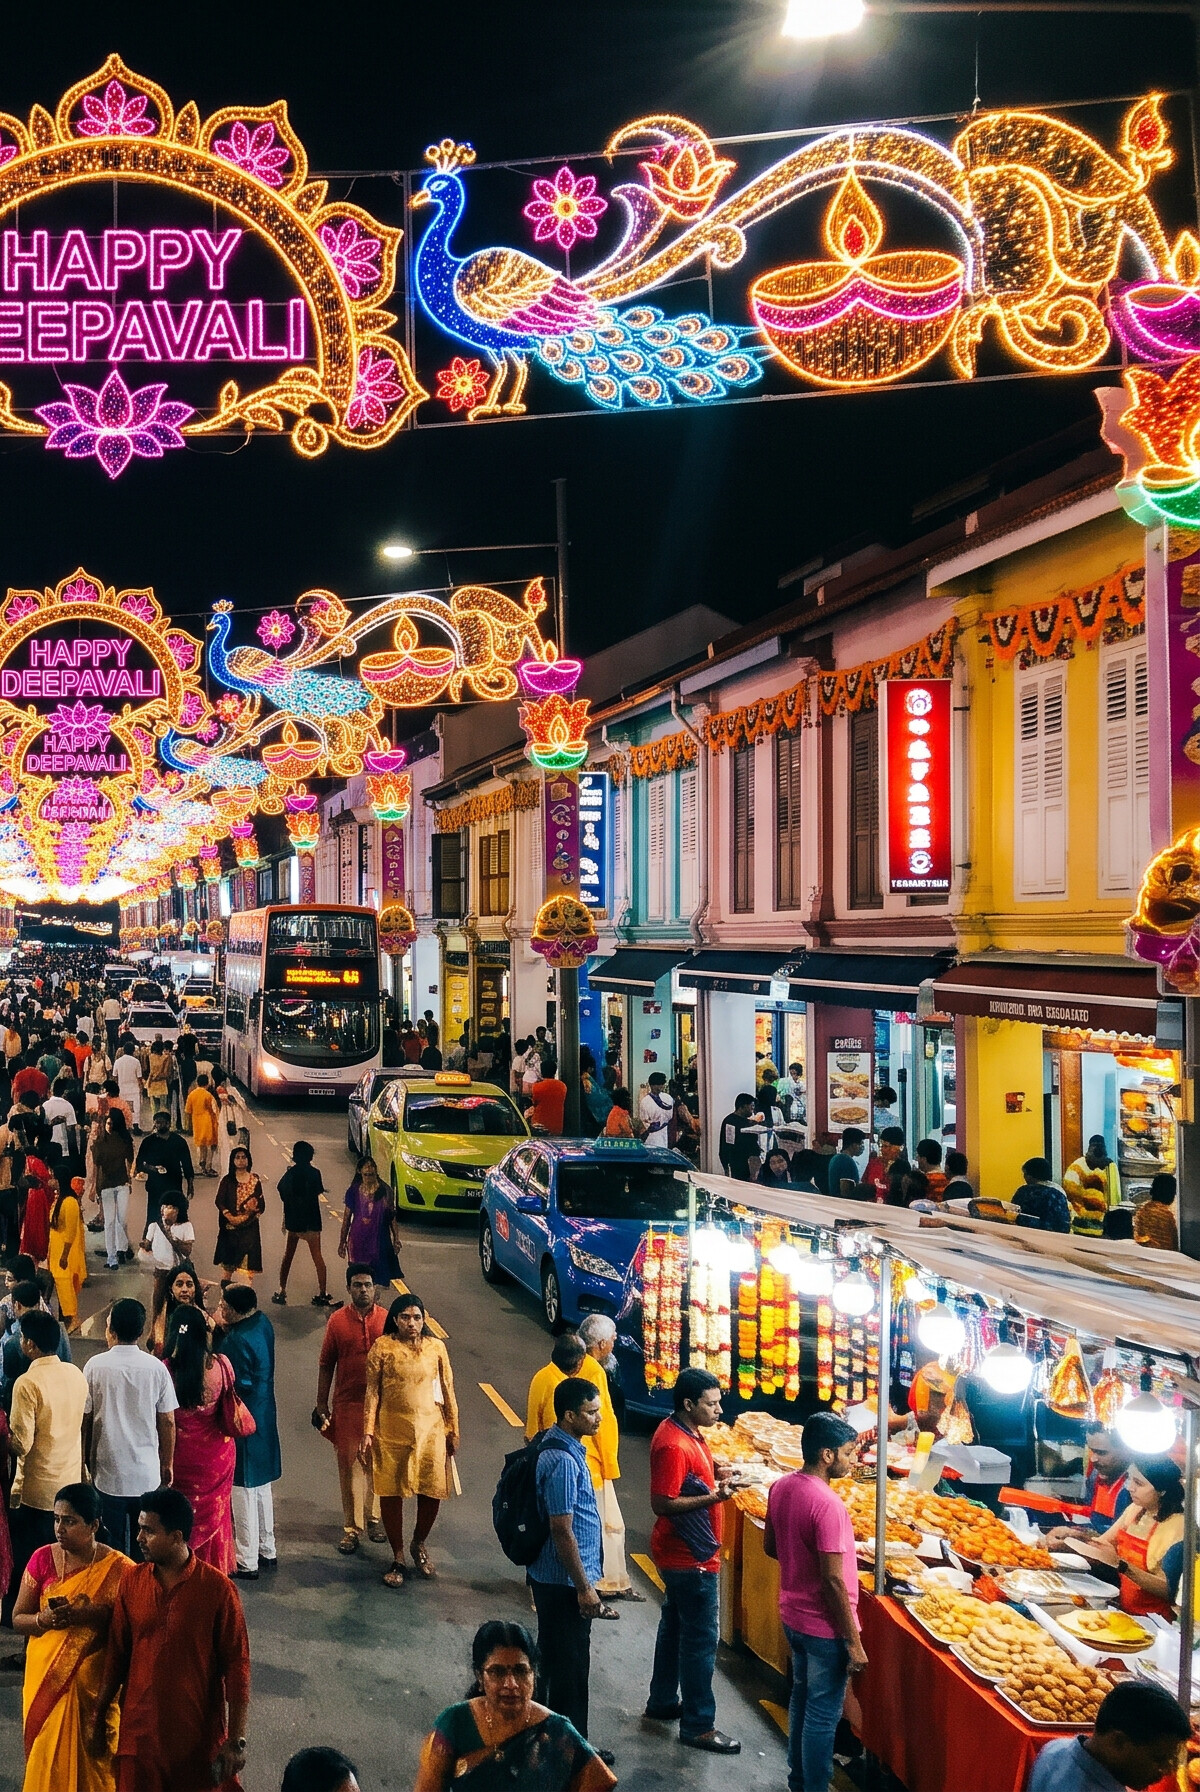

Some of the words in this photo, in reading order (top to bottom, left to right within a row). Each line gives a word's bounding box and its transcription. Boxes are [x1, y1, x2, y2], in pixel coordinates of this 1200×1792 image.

[2, 227, 242, 292] HAPPY
[30, 639, 133, 667] HAPPY
[1, 669, 161, 697] DEEPAVALI
[43, 734, 112, 753] HAPPY
[26, 754, 127, 772] DEEPAVALI
